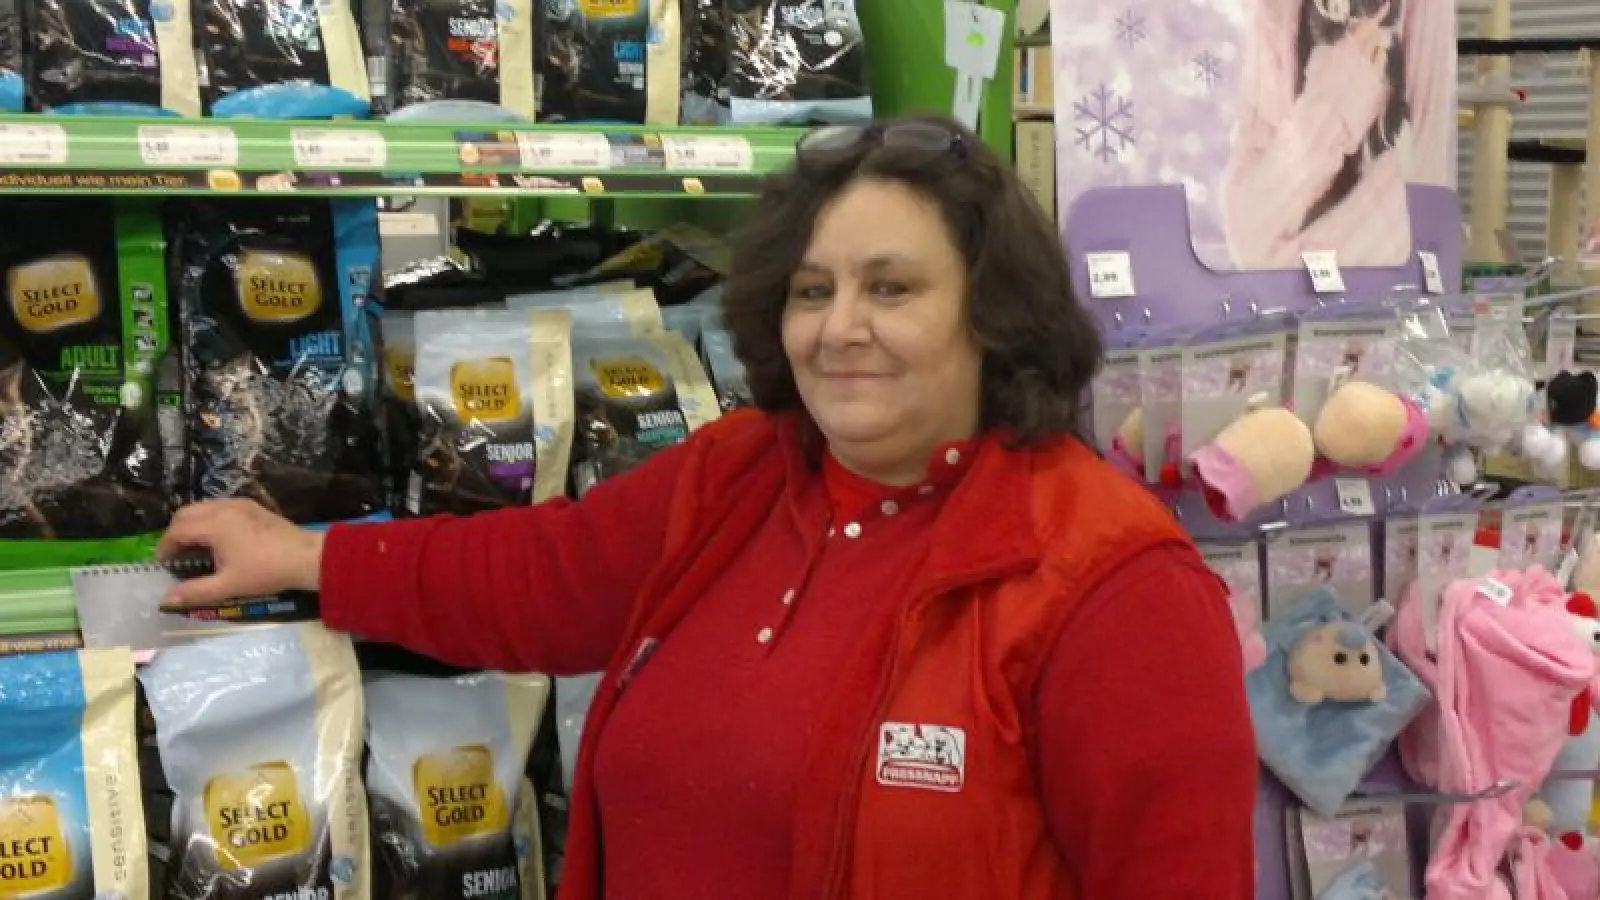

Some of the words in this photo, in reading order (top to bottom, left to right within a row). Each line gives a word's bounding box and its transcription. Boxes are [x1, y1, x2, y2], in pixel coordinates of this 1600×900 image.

[21, 281, 83, 303] SELECT
[250, 276, 307, 295] SELECT
[26, 298, 79, 319] GOLD
[255, 293, 304, 309] GOLD
[61, 346, 119, 370] ADULT
[460, 384, 509, 399] SELECT
[463, 399, 507, 413] GOLD
[638, 410, 683, 429] SENIOR
[486, 443, 534, 461] SENIOR
[428, 783, 489, 807] SELECT
[219, 800, 292, 831] SELECT
[435, 804, 485, 827] GOLD
[227, 823, 288, 850] GOLD
[462, 865, 517, 898] SENIOR
